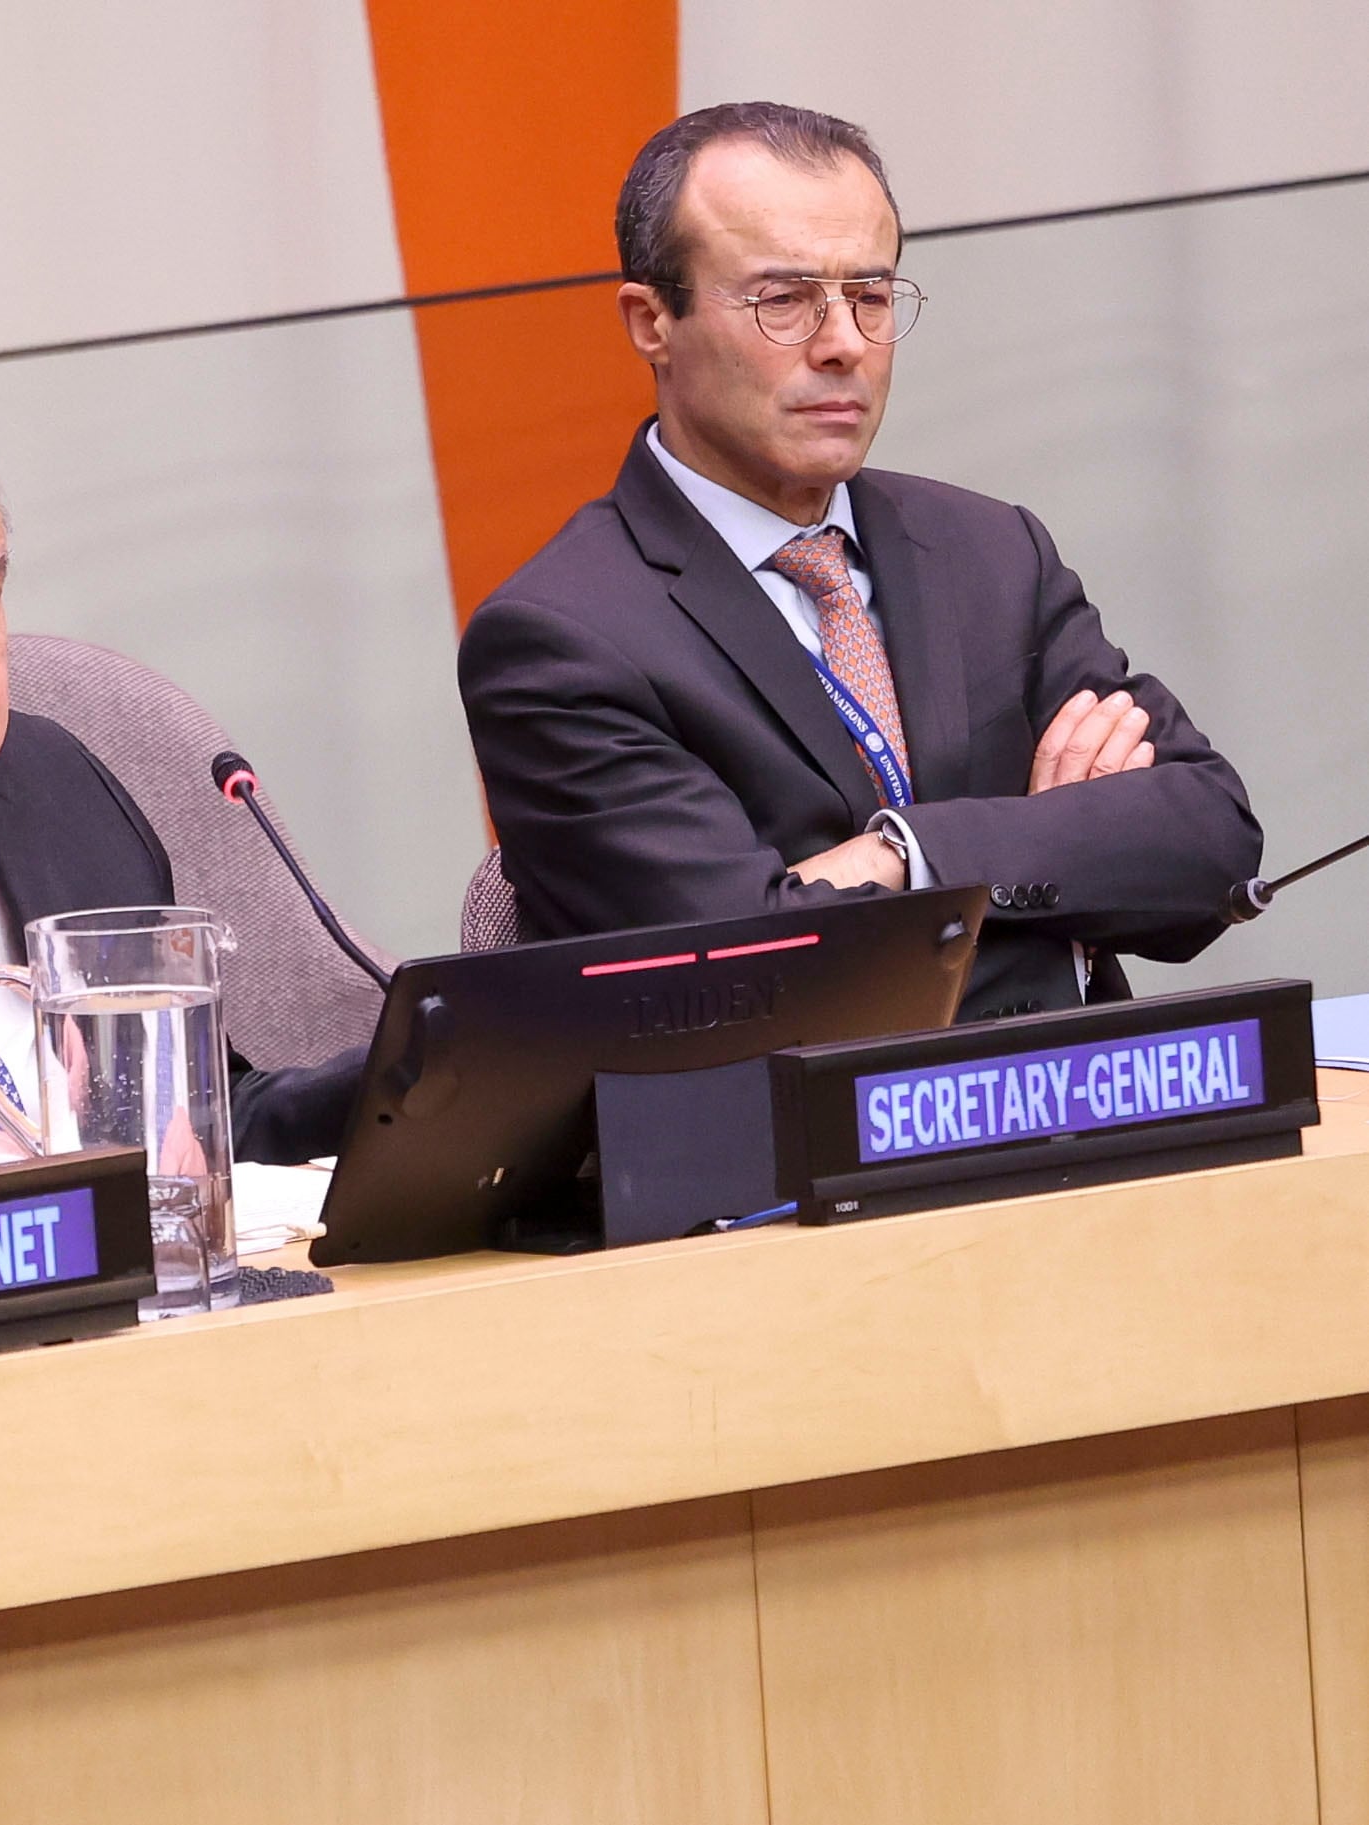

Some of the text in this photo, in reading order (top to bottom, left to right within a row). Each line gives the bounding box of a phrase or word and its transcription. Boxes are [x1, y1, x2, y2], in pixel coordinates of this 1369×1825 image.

[829, 689, 869, 733] NATIONS
[879, 754, 903, 798] UNITED
[867, 1034, 1250, 1153] SECRETARY-GENERAL
